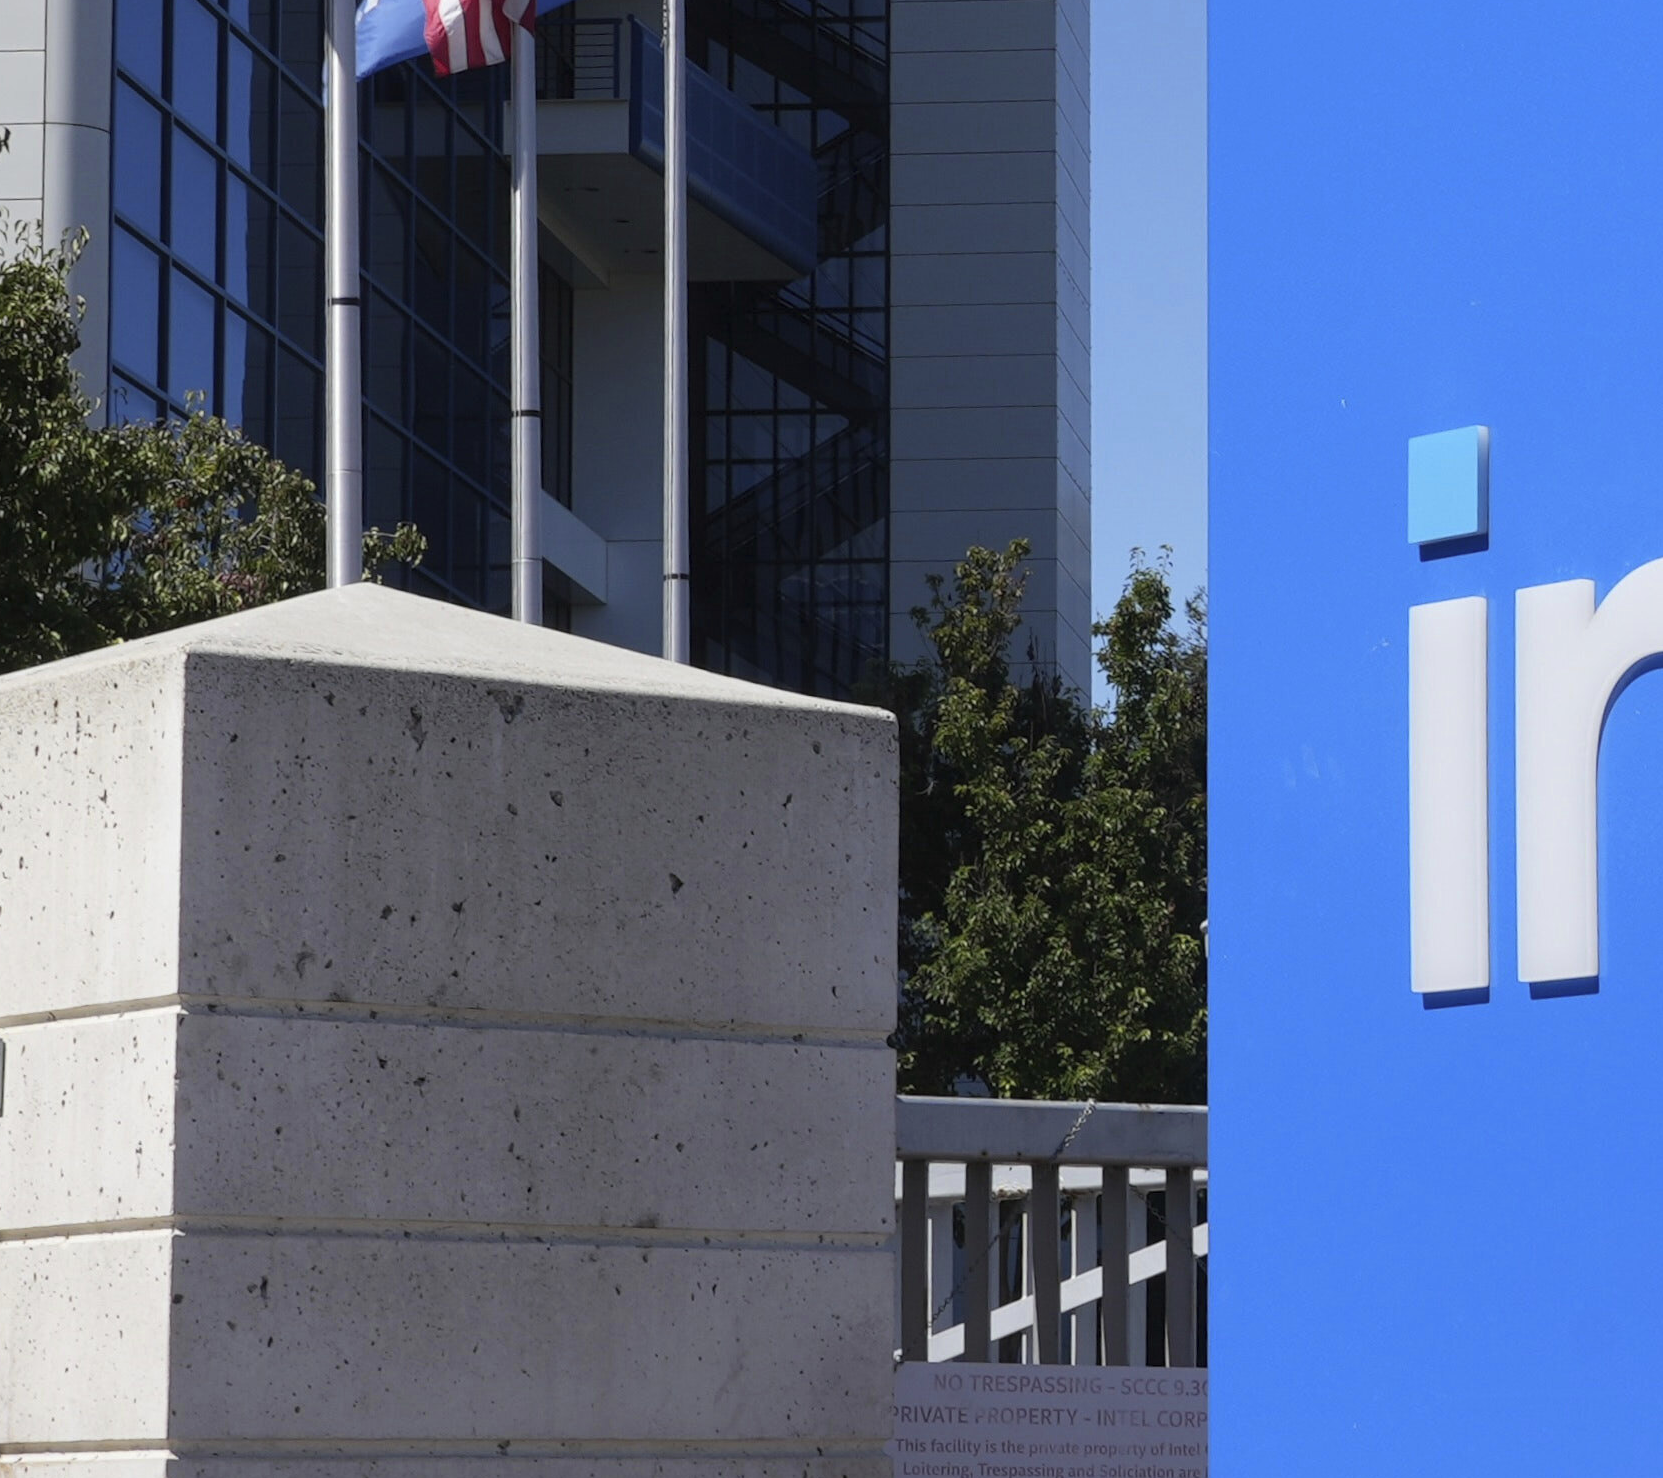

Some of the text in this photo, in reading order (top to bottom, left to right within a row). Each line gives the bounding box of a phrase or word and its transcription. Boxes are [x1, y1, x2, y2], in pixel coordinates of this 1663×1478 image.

[934, 1374, 963, 1391] NO
[968, 1375, 1102, 1395] TRESPASSING
[1121, 1378, 1168, 1396] SCCC
[975, 1407, 1077, 1425] PROPERTY
[1097, 1408, 1150, 1427] INTEL
[896, 1438, 926, 1452] This
[931, 1438, 981, 1456] facility
[986, 1440, 996, 1453] is
[1002, 1440, 1024, 1454] the
[1029, 1441, 1079, 1457] private
[1151, 1442, 1166, 1456] of
[1169, 1443, 1200, 1456] Intel
[1068, 1465, 1095, 1478] and
[1178, 1467, 1200, 1478] are
